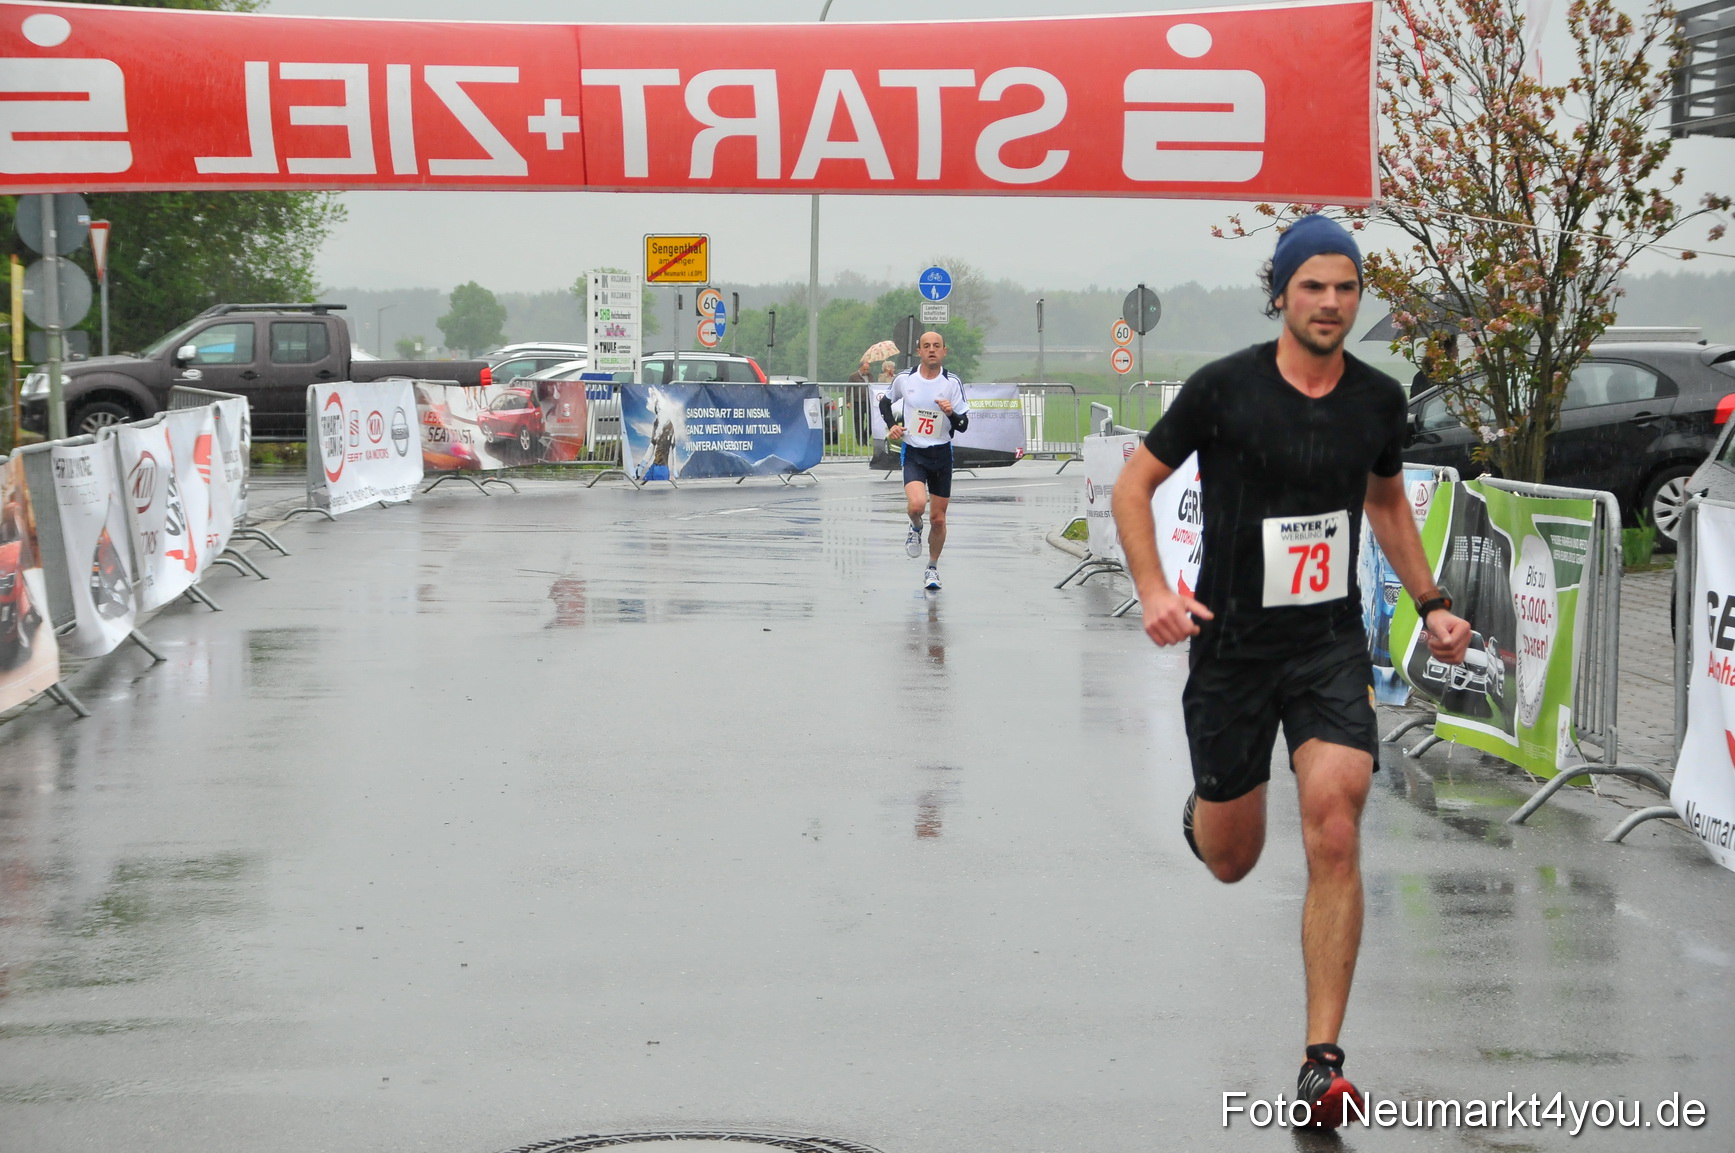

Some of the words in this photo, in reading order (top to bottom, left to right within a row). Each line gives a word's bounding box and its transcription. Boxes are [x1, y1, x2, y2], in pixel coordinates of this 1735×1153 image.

[652, 243, 702, 257] Sengenthal
[703, 297, 718, 310] 60
[1116, 327, 1129, 339] 60
[600, 342, 617, 354] THULE
[733, 408, 745, 418] BEI
[370, 419, 381, 435] KIA
[686, 425, 704, 435] GANZ
[745, 425, 757, 434] MIT
[758, 425, 782, 434] TOLLEN
[918, 418, 934, 435] 75
[347, 452, 363, 463] SEAT
[1281, 521, 1322, 533] MEYER
[1282, 531, 1322, 541] WERBUNG
[1289, 542, 1331, 595] 73
[1526, 565, 1538, 587] Bis
